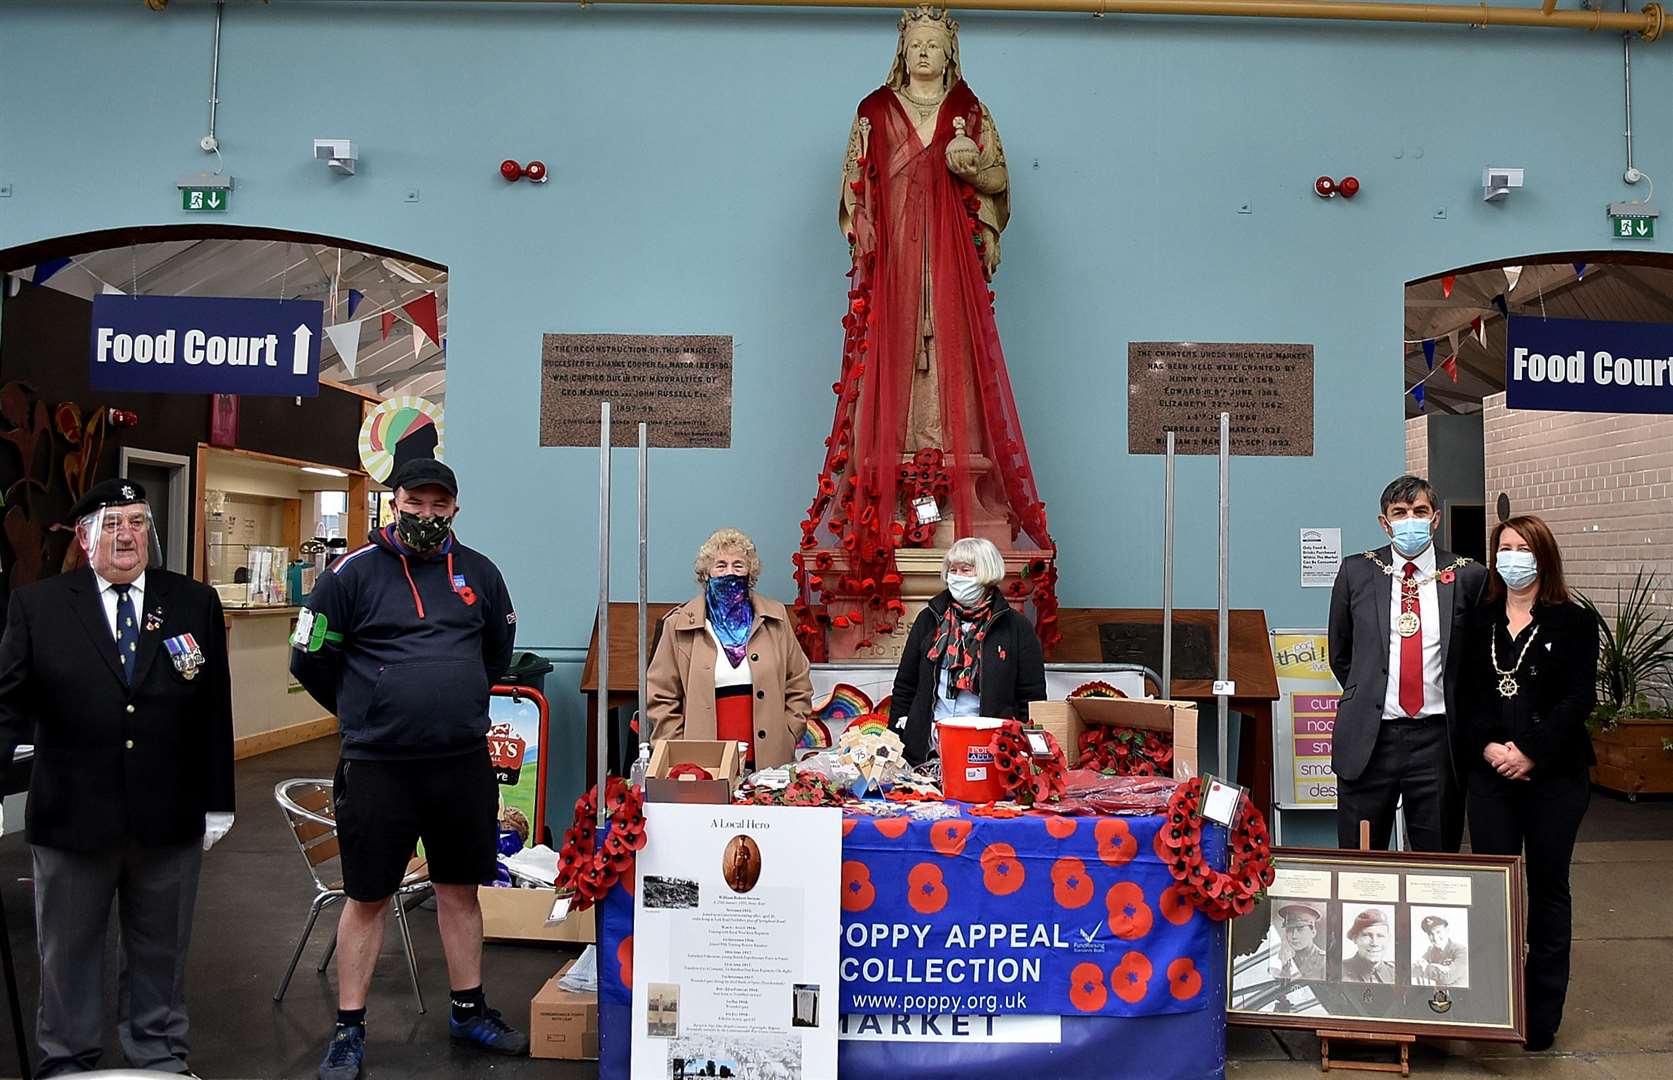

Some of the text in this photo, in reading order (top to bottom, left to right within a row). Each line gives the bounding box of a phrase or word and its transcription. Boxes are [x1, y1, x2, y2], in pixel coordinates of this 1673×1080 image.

[97, 328, 278, 366] Food Court
[573, 346, 647, 354] RECONSTRUCTION
[1155, 350, 1198, 358] CHARTERS
[1513, 347, 1585, 384] Food
[657, 390, 692, 398] RUSSELL
[1301, 764, 1333, 776] smo
[711, 818, 770, 830] A Local Hero
[840, 923, 1070, 949] OPPY APPEAL
[840, 957, 1041, 983] COLLECTION
[853, 992, 1028, 1013] www.poppy.org.uk
